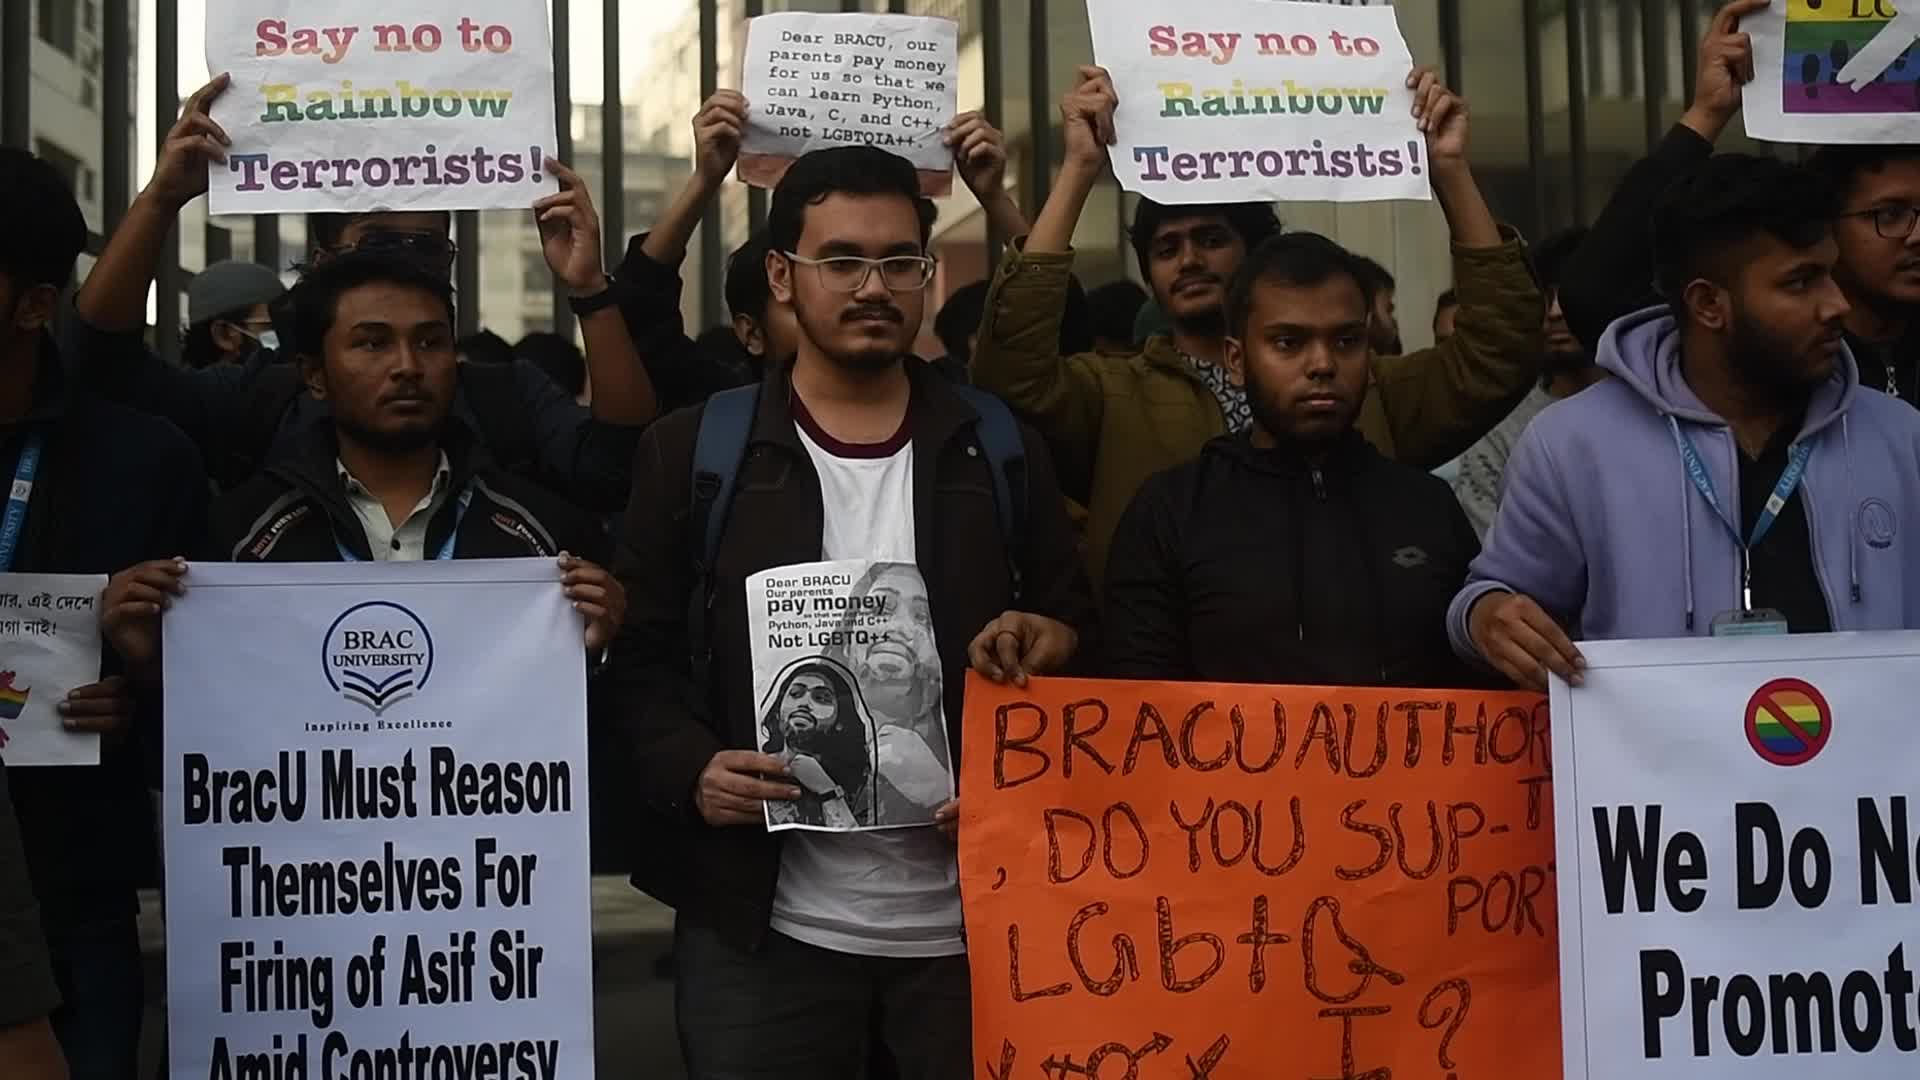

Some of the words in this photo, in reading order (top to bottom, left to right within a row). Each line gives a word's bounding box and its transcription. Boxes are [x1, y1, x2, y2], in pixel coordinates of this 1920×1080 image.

[256, 19, 359, 64] Say
[373, 22, 441, 53] no
[458, 17, 512, 53] to
[782, 31, 823, 45] Dear
[834, 34, 893, 50] BRACU,
[907, 41, 937, 51] our
[1148, 25, 1242, 65] Say
[1254, 31, 1317, 56] no
[1329, 30, 1380, 57] to
[769, 50, 842, 63] parents
[853, 55, 884, 69] pay
[894, 60, 946, 75] money
[769, 66, 800, 79] for
[811, 71, 830, 81] us
[842, 73, 862, 84] so
[875, 73, 914, 90] that
[925, 81, 945, 92] we
[260, 80, 513, 122] Rainbow
[767, 88, 798, 98] can
[809, 88, 861, 103] learn
[872, 93, 941, 112] Python,
[1158, 79, 1388, 117] Rainbow
[765, 104, 815, 121] Java,
[828, 108, 847, 124] C,
[860, 113, 891, 126] and
[779, 126, 812, 138] not
[230, 144, 543, 191] Terrorists!
[1133, 139, 1422, 181] Terrorists!
[766, 578, 799, 588] Dear
[802, 575, 851, 586] BRACU
[766, 589, 787, 598] Our
[790, 588, 834, 599] parents
[28, 592, 52, 611] এই
[57, 596, 94, 610] দেশে
[767, 598, 806, 617] pay
[813, 595, 887, 616] money
[768, 620, 812, 632] Python,
[815, 619, 841, 628] Java
[844, 617, 864, 627] and
[867, 617, 888, 626] C++
[344, 629, 414, 650] BRAC
[768, 633, 803, 648] Not
[808, 630, 890, 647] LGBTQ++
[333, 652, 425, 667] UNIVERSITY
[305, 721, 370, 733] Inspiring
[377, 719, 453, 731] Excellence
[183, 750, 307, 824] BracU
[322, 747, 417, 820] Must
[430, 746, 571, 816] Reason
[1044, 801, 1150, 884] DO
[1171, 795, 1305, 878] YOU
[1592, 804, 1708, 914] We
[1735, 801, 1831, 909] Do
[1857, 795, 1920, 906] N
[222, 841, 461, 918] Themselves
[474, 837, 537, 908] For
[220, 940, 334, 1029] Firing
[346, 935, 386, 1009] of
[399, 931, 476, 1006] Asif
[489, 929, 544, 1001] Sir
[1639, 941, 1920, 1059] Promot
[208, 1034, 308, 1080] Amid
[321, 1030, 560, 1080] Controversy
